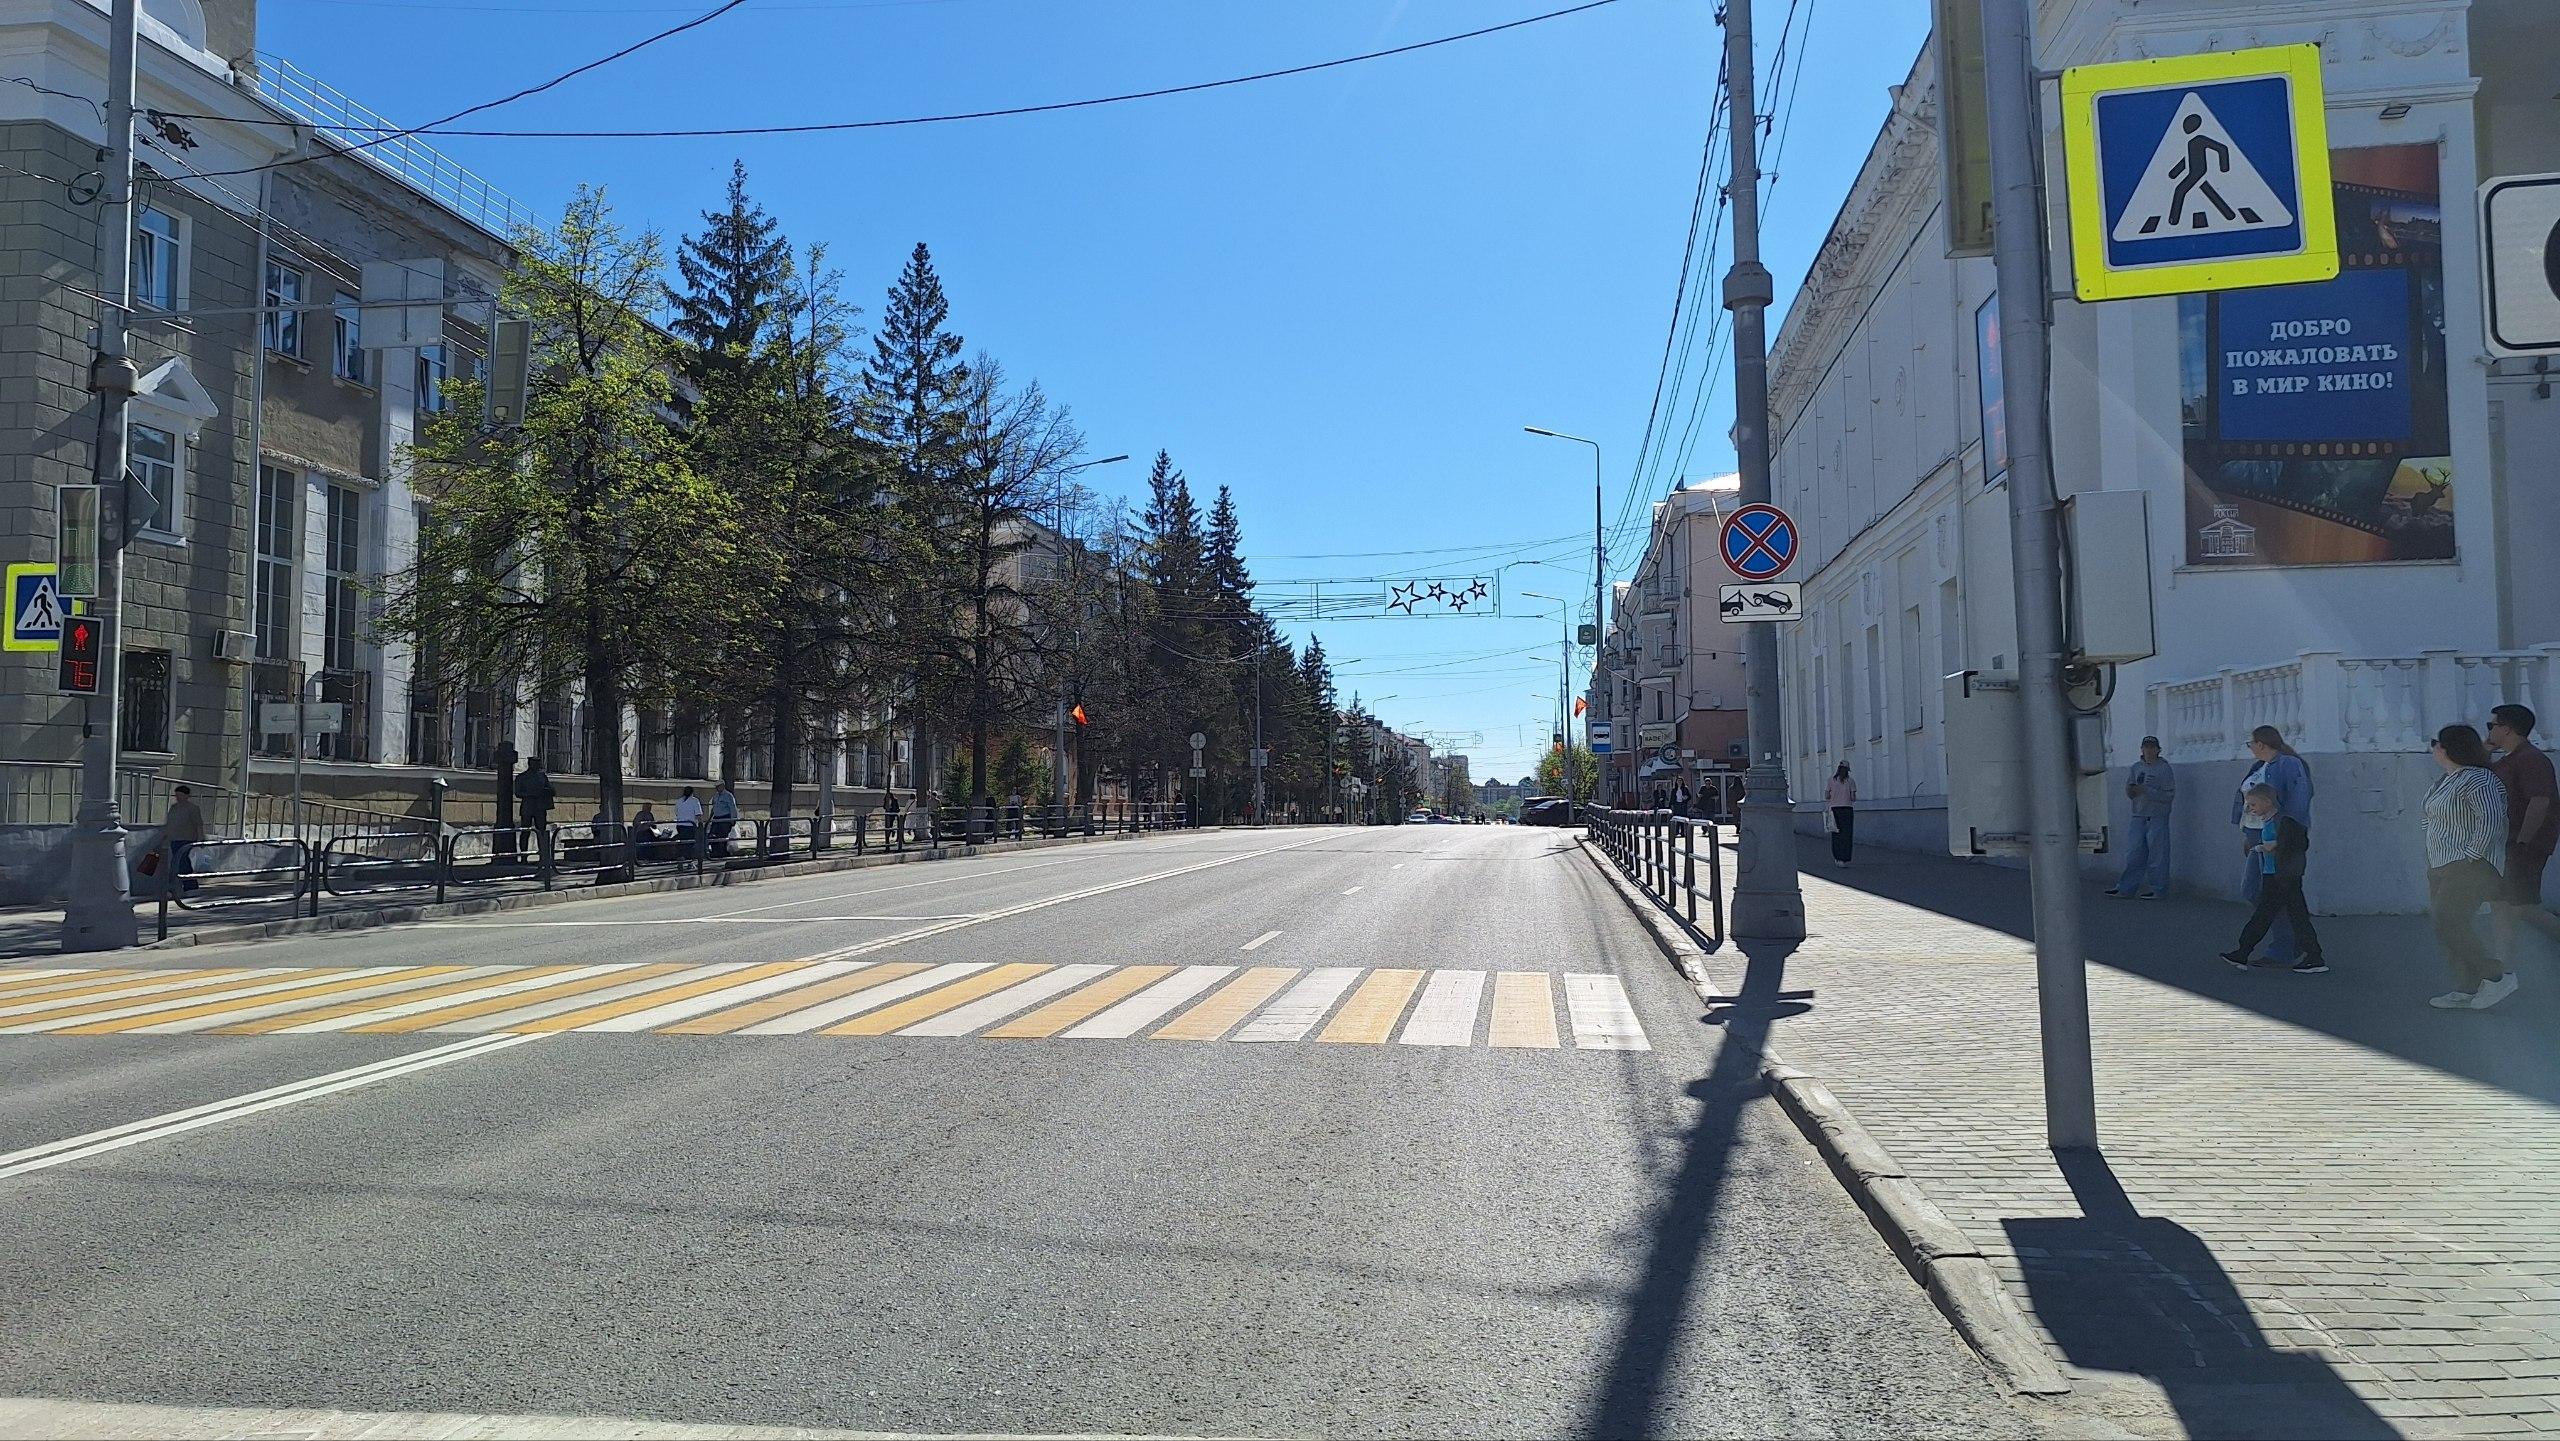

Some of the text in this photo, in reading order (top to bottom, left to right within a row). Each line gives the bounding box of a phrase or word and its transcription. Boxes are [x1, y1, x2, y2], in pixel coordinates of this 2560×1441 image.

[2270, 318, 2351, 341] ДОБРО
[2226, 344, 2398, 368] ПОЖАЛОВАТЬ
[2232, 371, 2393, 395] В МИР КИНО!
[64, 659, 94, 687] 76
